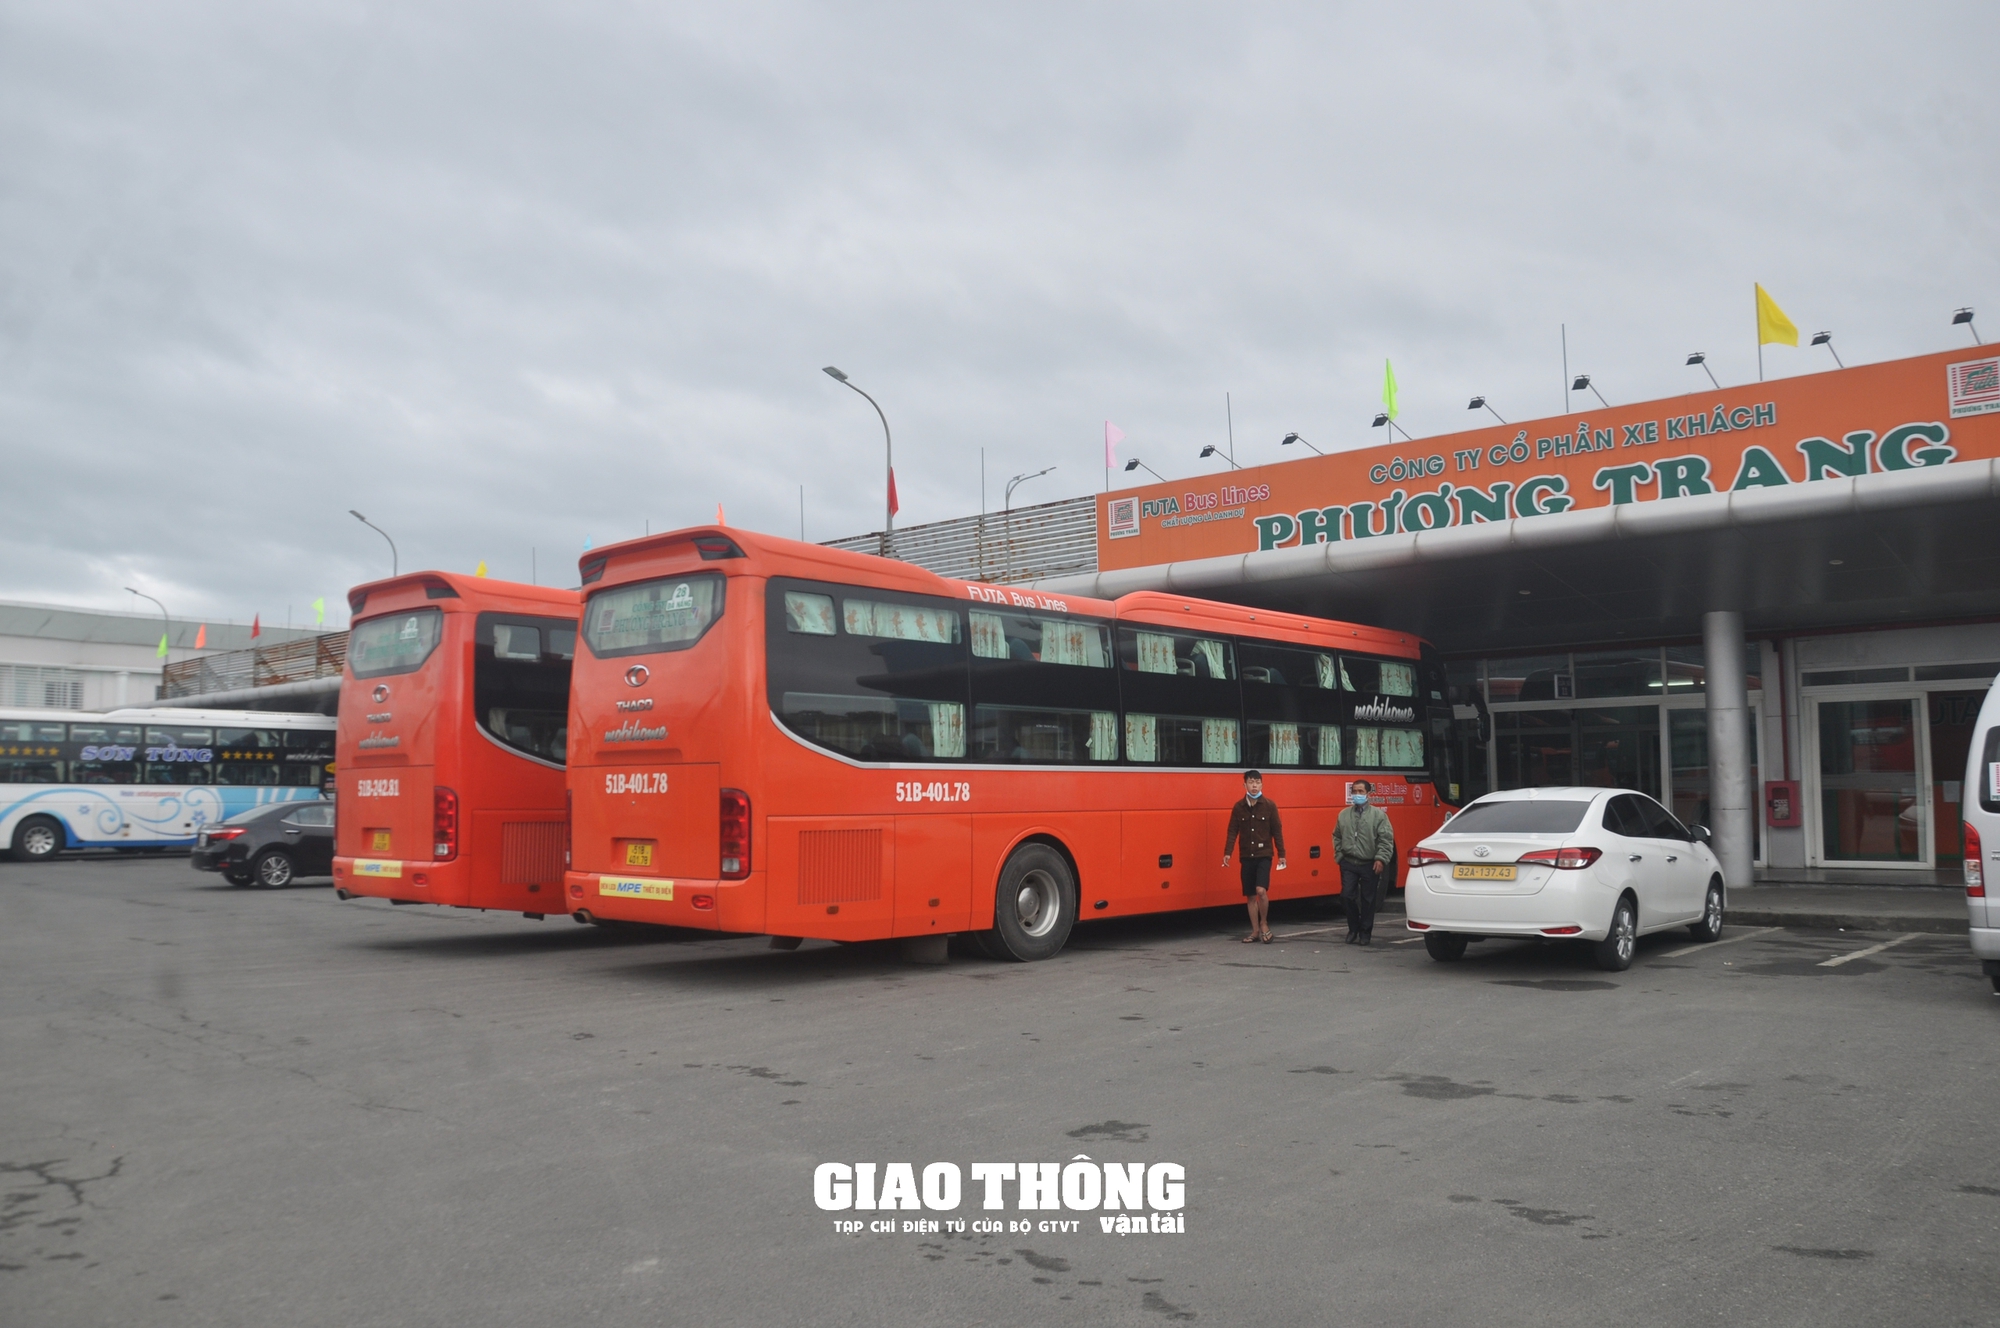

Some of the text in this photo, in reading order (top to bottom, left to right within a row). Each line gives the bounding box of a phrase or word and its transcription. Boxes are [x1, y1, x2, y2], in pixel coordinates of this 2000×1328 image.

[1984, 402, 2000, 410] TRA
[1369, 401, 1777, 485] CÔNG TY CỔ PHẦN XE KHÁCH
[1254, 421, 1958, 551] PHƯƠNG TRANG
[1142, 484, 1270, 519] FUTA Bus Lines
[676, 587, 687, 598] 28
[966, 585, 1068, 612] FUTA Bus Lines
[616, 698, 653, 712] THACO
[1354, 695, 1415, 722] mobihome
[604, 719, 669, 743] mobihome
[80, 744, 137, 761] SƠN
[358, 779, 399, 797] 51B-242.81
[605, 772, 668, 794] 51B-401.78
[896, 782, 970, 802] 51B-401.78
[1458, 867, 1511, 878] 92A-137.43
[617, 882, 642, 893] MPE
